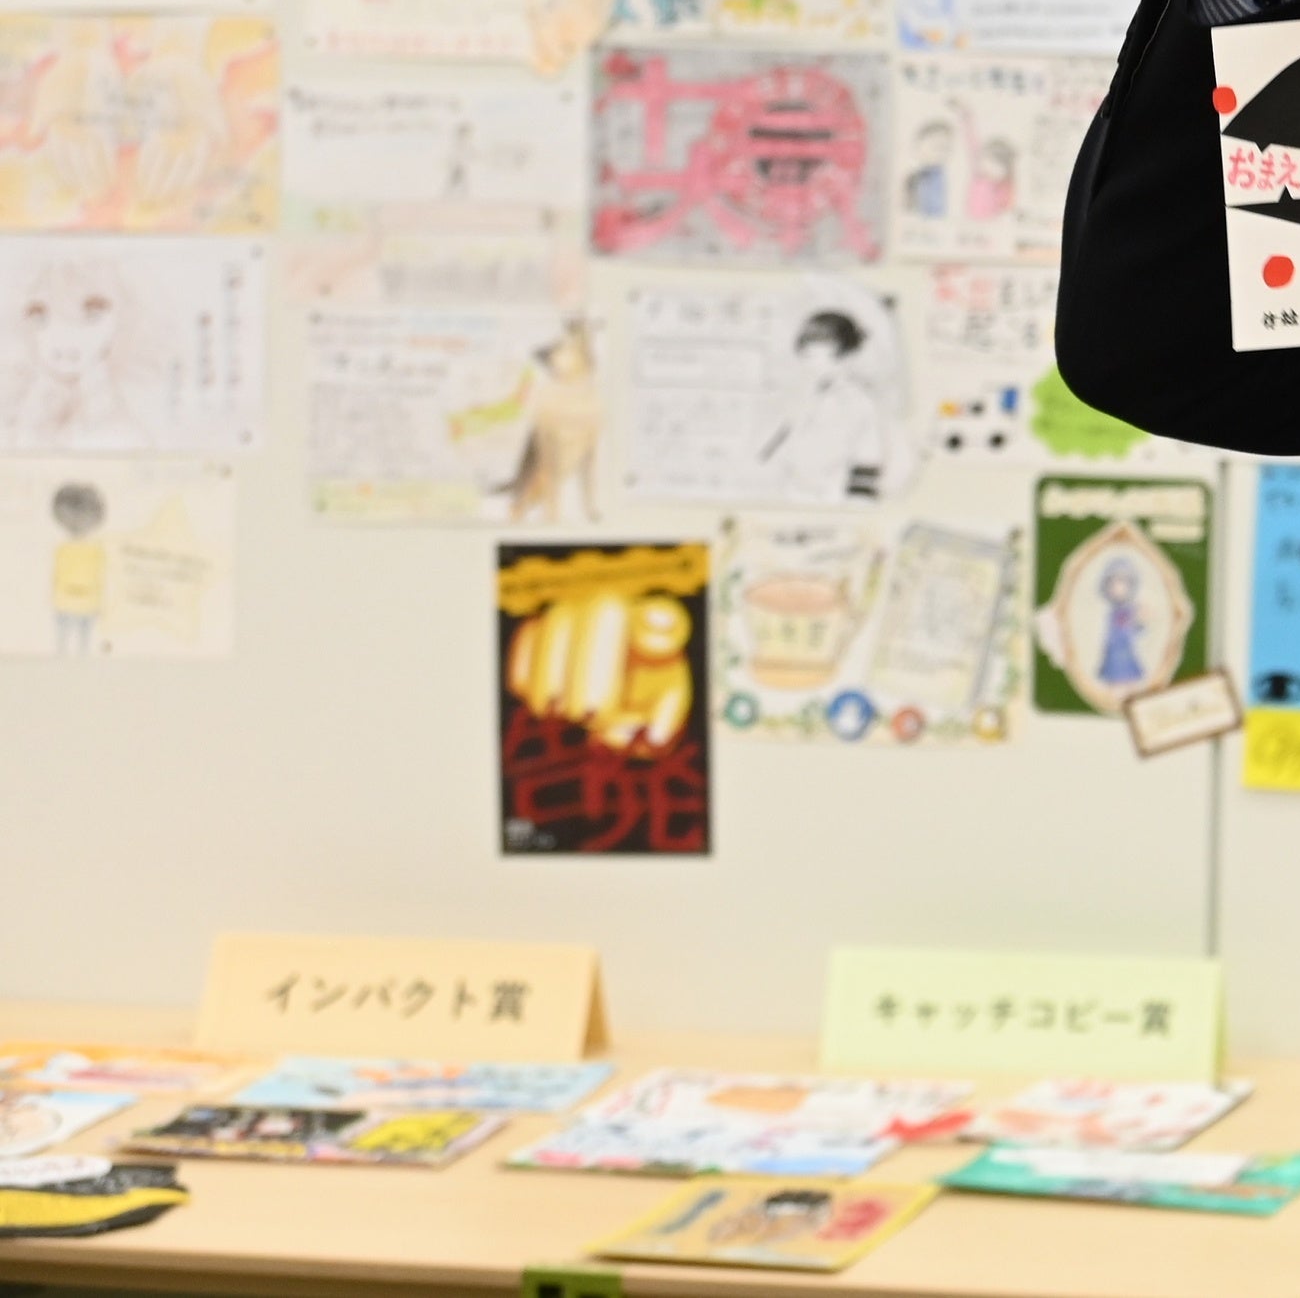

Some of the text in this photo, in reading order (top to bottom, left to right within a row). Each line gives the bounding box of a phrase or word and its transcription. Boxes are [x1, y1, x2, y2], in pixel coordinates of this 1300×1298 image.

[267, 971, 531, 1024] インパクト賞
[873, 992, 1175, 1038] キャッチコピー賞
